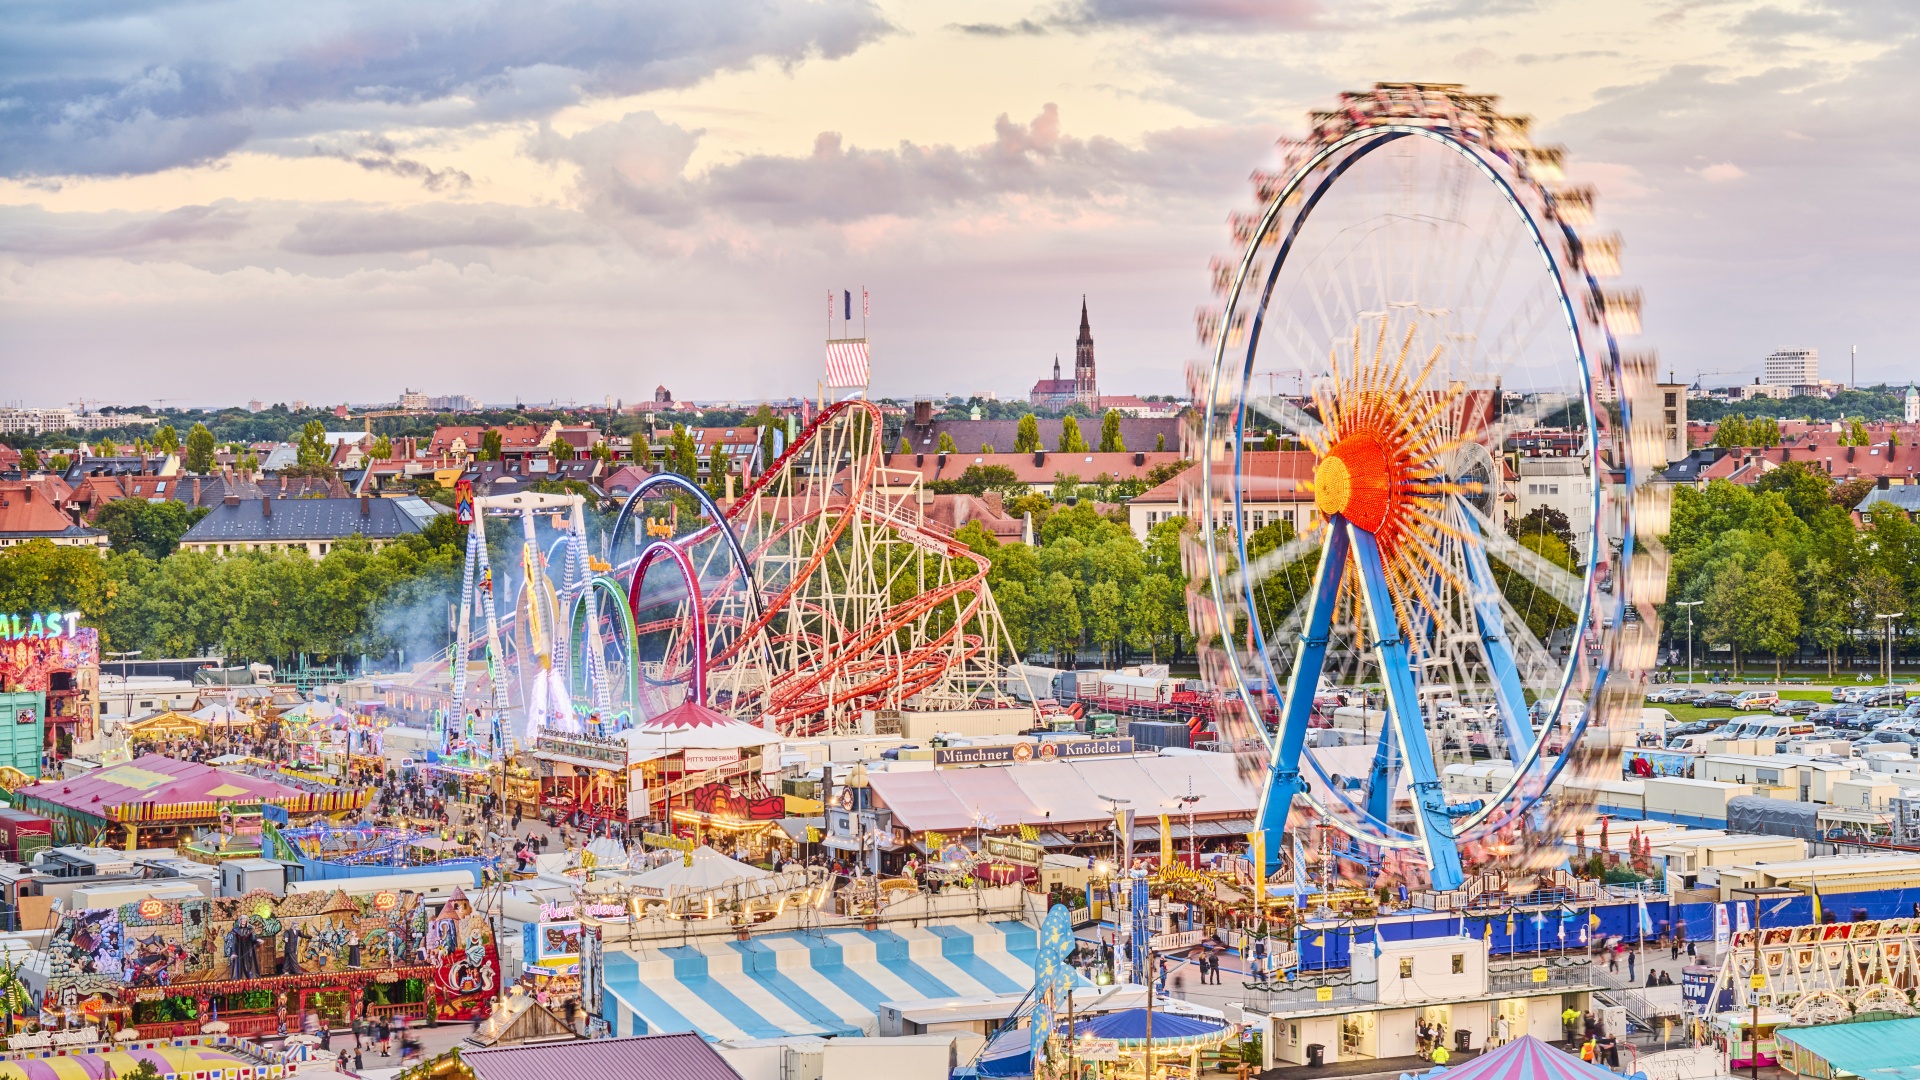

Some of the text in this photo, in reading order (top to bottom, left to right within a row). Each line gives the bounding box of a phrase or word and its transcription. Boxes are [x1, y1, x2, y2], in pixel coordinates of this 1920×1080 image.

[942, 750, 1008, 764] Münchner
[1065, 740, 1121, 756] Knödelei
[1159, 860, 1215, 893] Willenborg
[539, 900, 627, 922] Herzalerei
[1683, 983, 1706, 998] ATM
